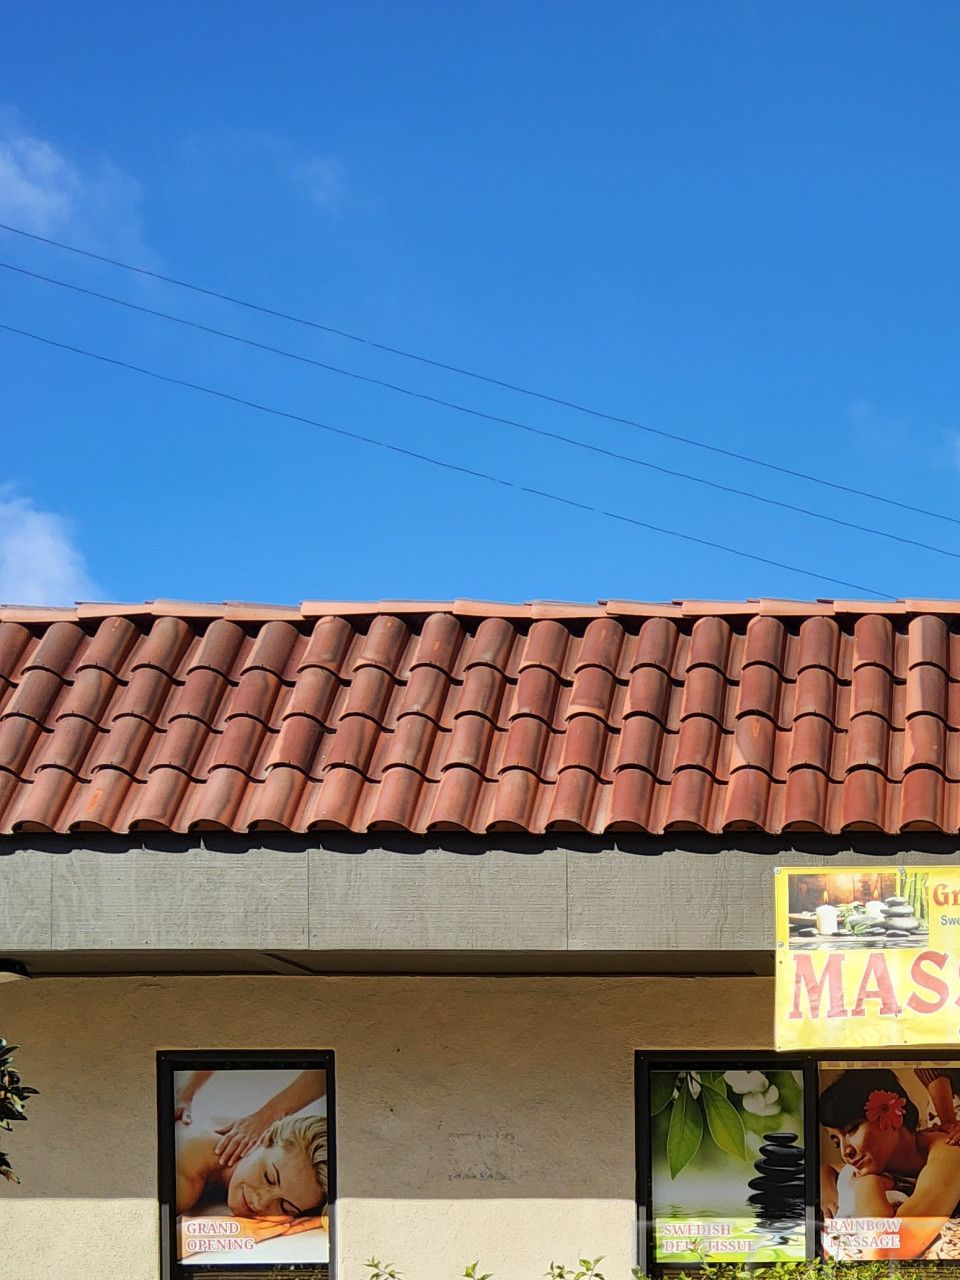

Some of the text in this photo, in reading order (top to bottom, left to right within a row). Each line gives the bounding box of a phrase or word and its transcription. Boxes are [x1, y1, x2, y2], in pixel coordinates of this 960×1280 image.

[186, 1222, 239, 1234] GRAND
[663, 1224, 731, 1236] SWEDISH
[829, 1219, 900, 1232] RAINBOW
[186, 1238, 254, 1251] OPENING
